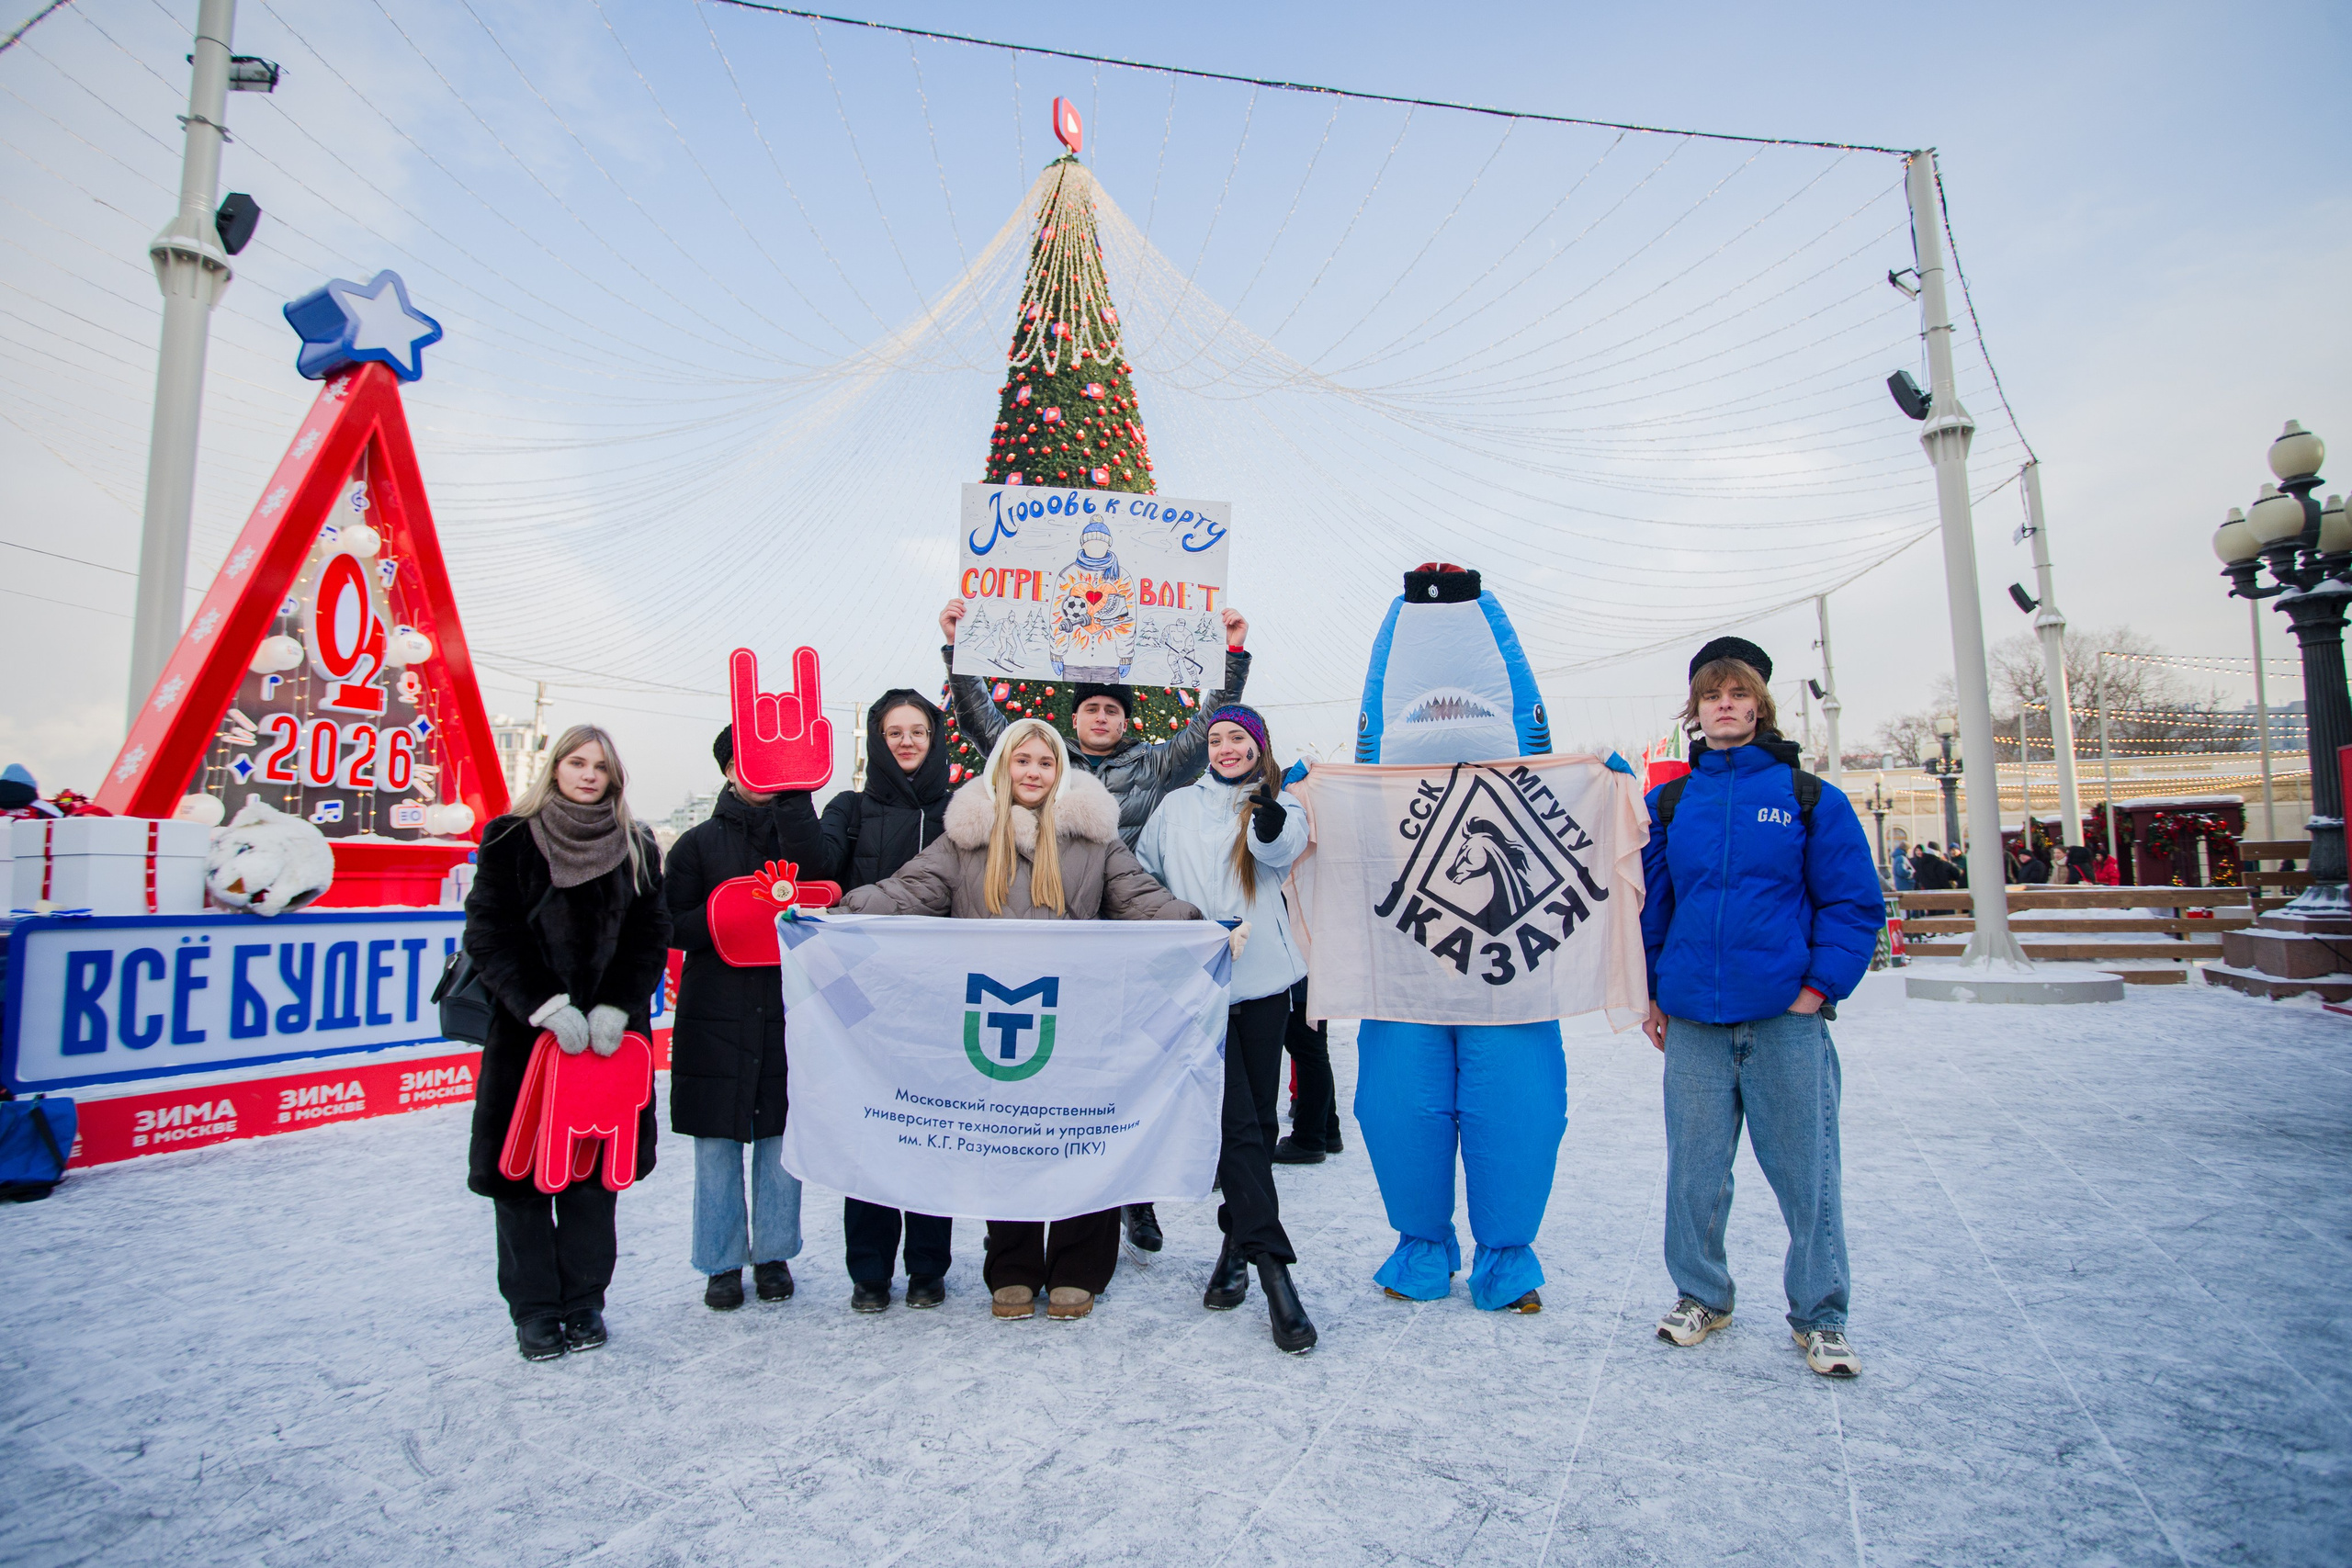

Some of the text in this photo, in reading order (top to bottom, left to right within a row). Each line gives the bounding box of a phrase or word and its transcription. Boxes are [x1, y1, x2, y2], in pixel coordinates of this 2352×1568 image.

[266, 716, 413, 790] 2026
[1399, 765, 1593, 852] ССК МГУТУ
[1758, 808, 1792, 827] GAP
[1396, 885, 1590, 986] КАЗАК
[61, 935, 428, 1056] ВСЁ БУДЕТ
[400, 1065, 473, 1091] ЗИМА
[278, 1080, 366, 1110] ЗИМА
[398, 1083, 473, 1104] В МОСКВЕ
[895, 1088, 1115, 1119] Московский государственный
[133, 1099, 238, 1132] ЗИМА
[278, 1100, 366, 1123] В МОСКВЕ
[864, 1107, 1140, 1140] университет технологий и управления
[132, 1120, 237, 1147] В МОСКВЕ
[899, 1134, 1106, 1159] им. К.Г. Разумовского (ПКУ)
